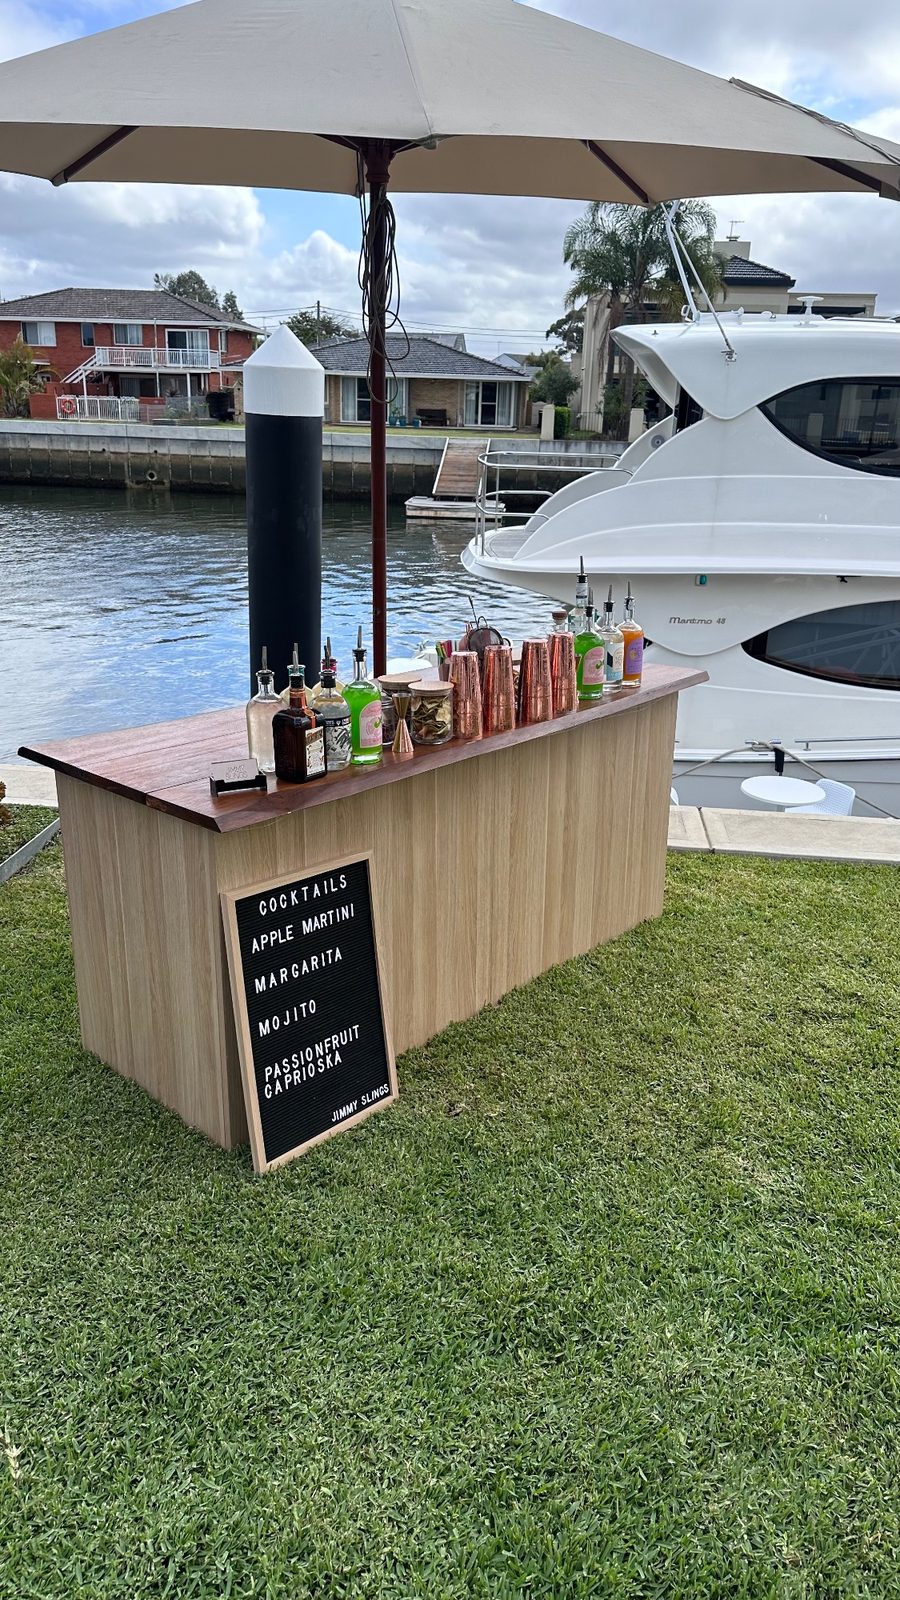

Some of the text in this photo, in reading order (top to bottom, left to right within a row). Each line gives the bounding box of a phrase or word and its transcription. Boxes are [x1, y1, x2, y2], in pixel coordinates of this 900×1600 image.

[258, 873, 348, 916] COCKTAILS
[251, 902, 355, 954] APPLE MARTINI
[254, 946, 343, 994] MARGARITA
[258, 999, 316, 1038] MOJITO
[264, 1024, 361, 1083] PASSIONFRUIT
[264, 1050, 342, 1099] CAPRIOSKA
[331, 1083, 390, 1122] JIMMY SLINGS
